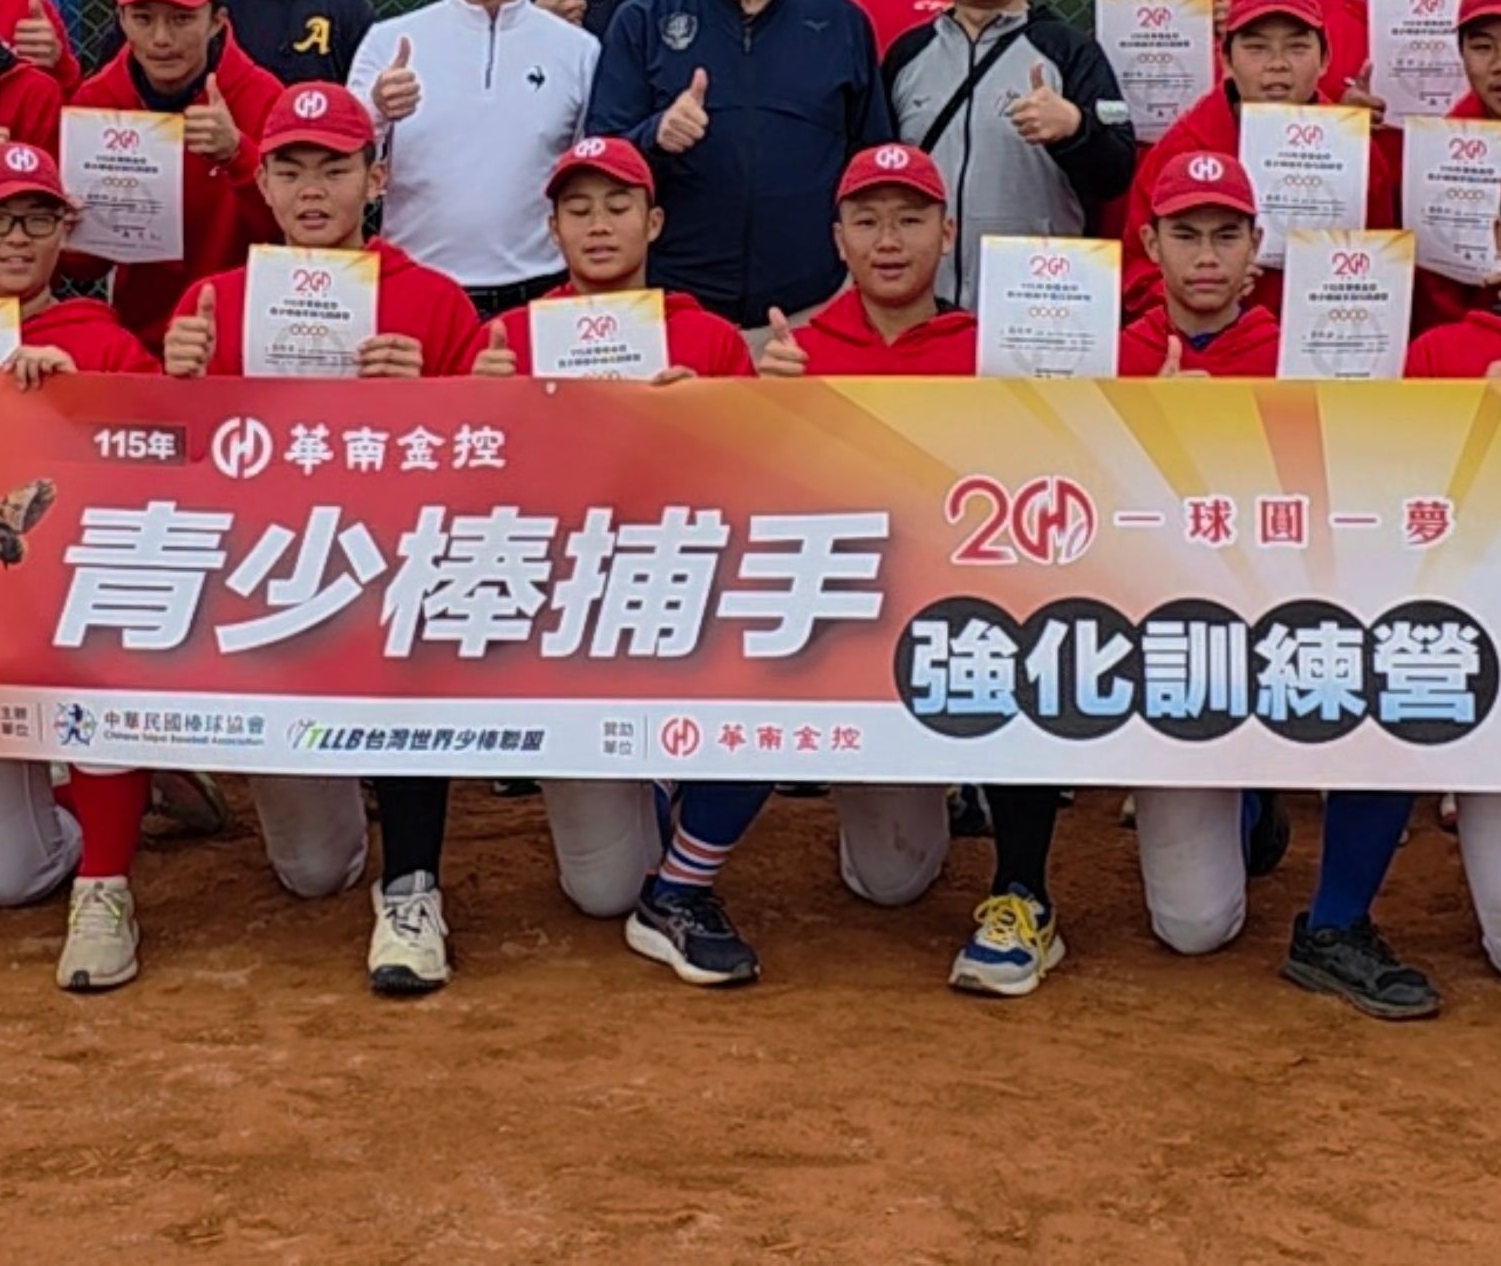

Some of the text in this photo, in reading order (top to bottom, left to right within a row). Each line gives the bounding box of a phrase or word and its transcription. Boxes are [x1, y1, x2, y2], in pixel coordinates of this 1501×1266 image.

[292, 15, 332, 56] A
[93, 428, 177, 460] 115年
[284, 420, 507, 476] 華南金控
[1117, 495, 1456, 547] 一球圓一夢
[53, 498, 891, 659] 青少棒捕手
[910, 616, 1481, 725] 強化訓練營
[103, 709, 266, 735] 中華民國棒球協會
[717, 723, 862, 752] 華南金控
